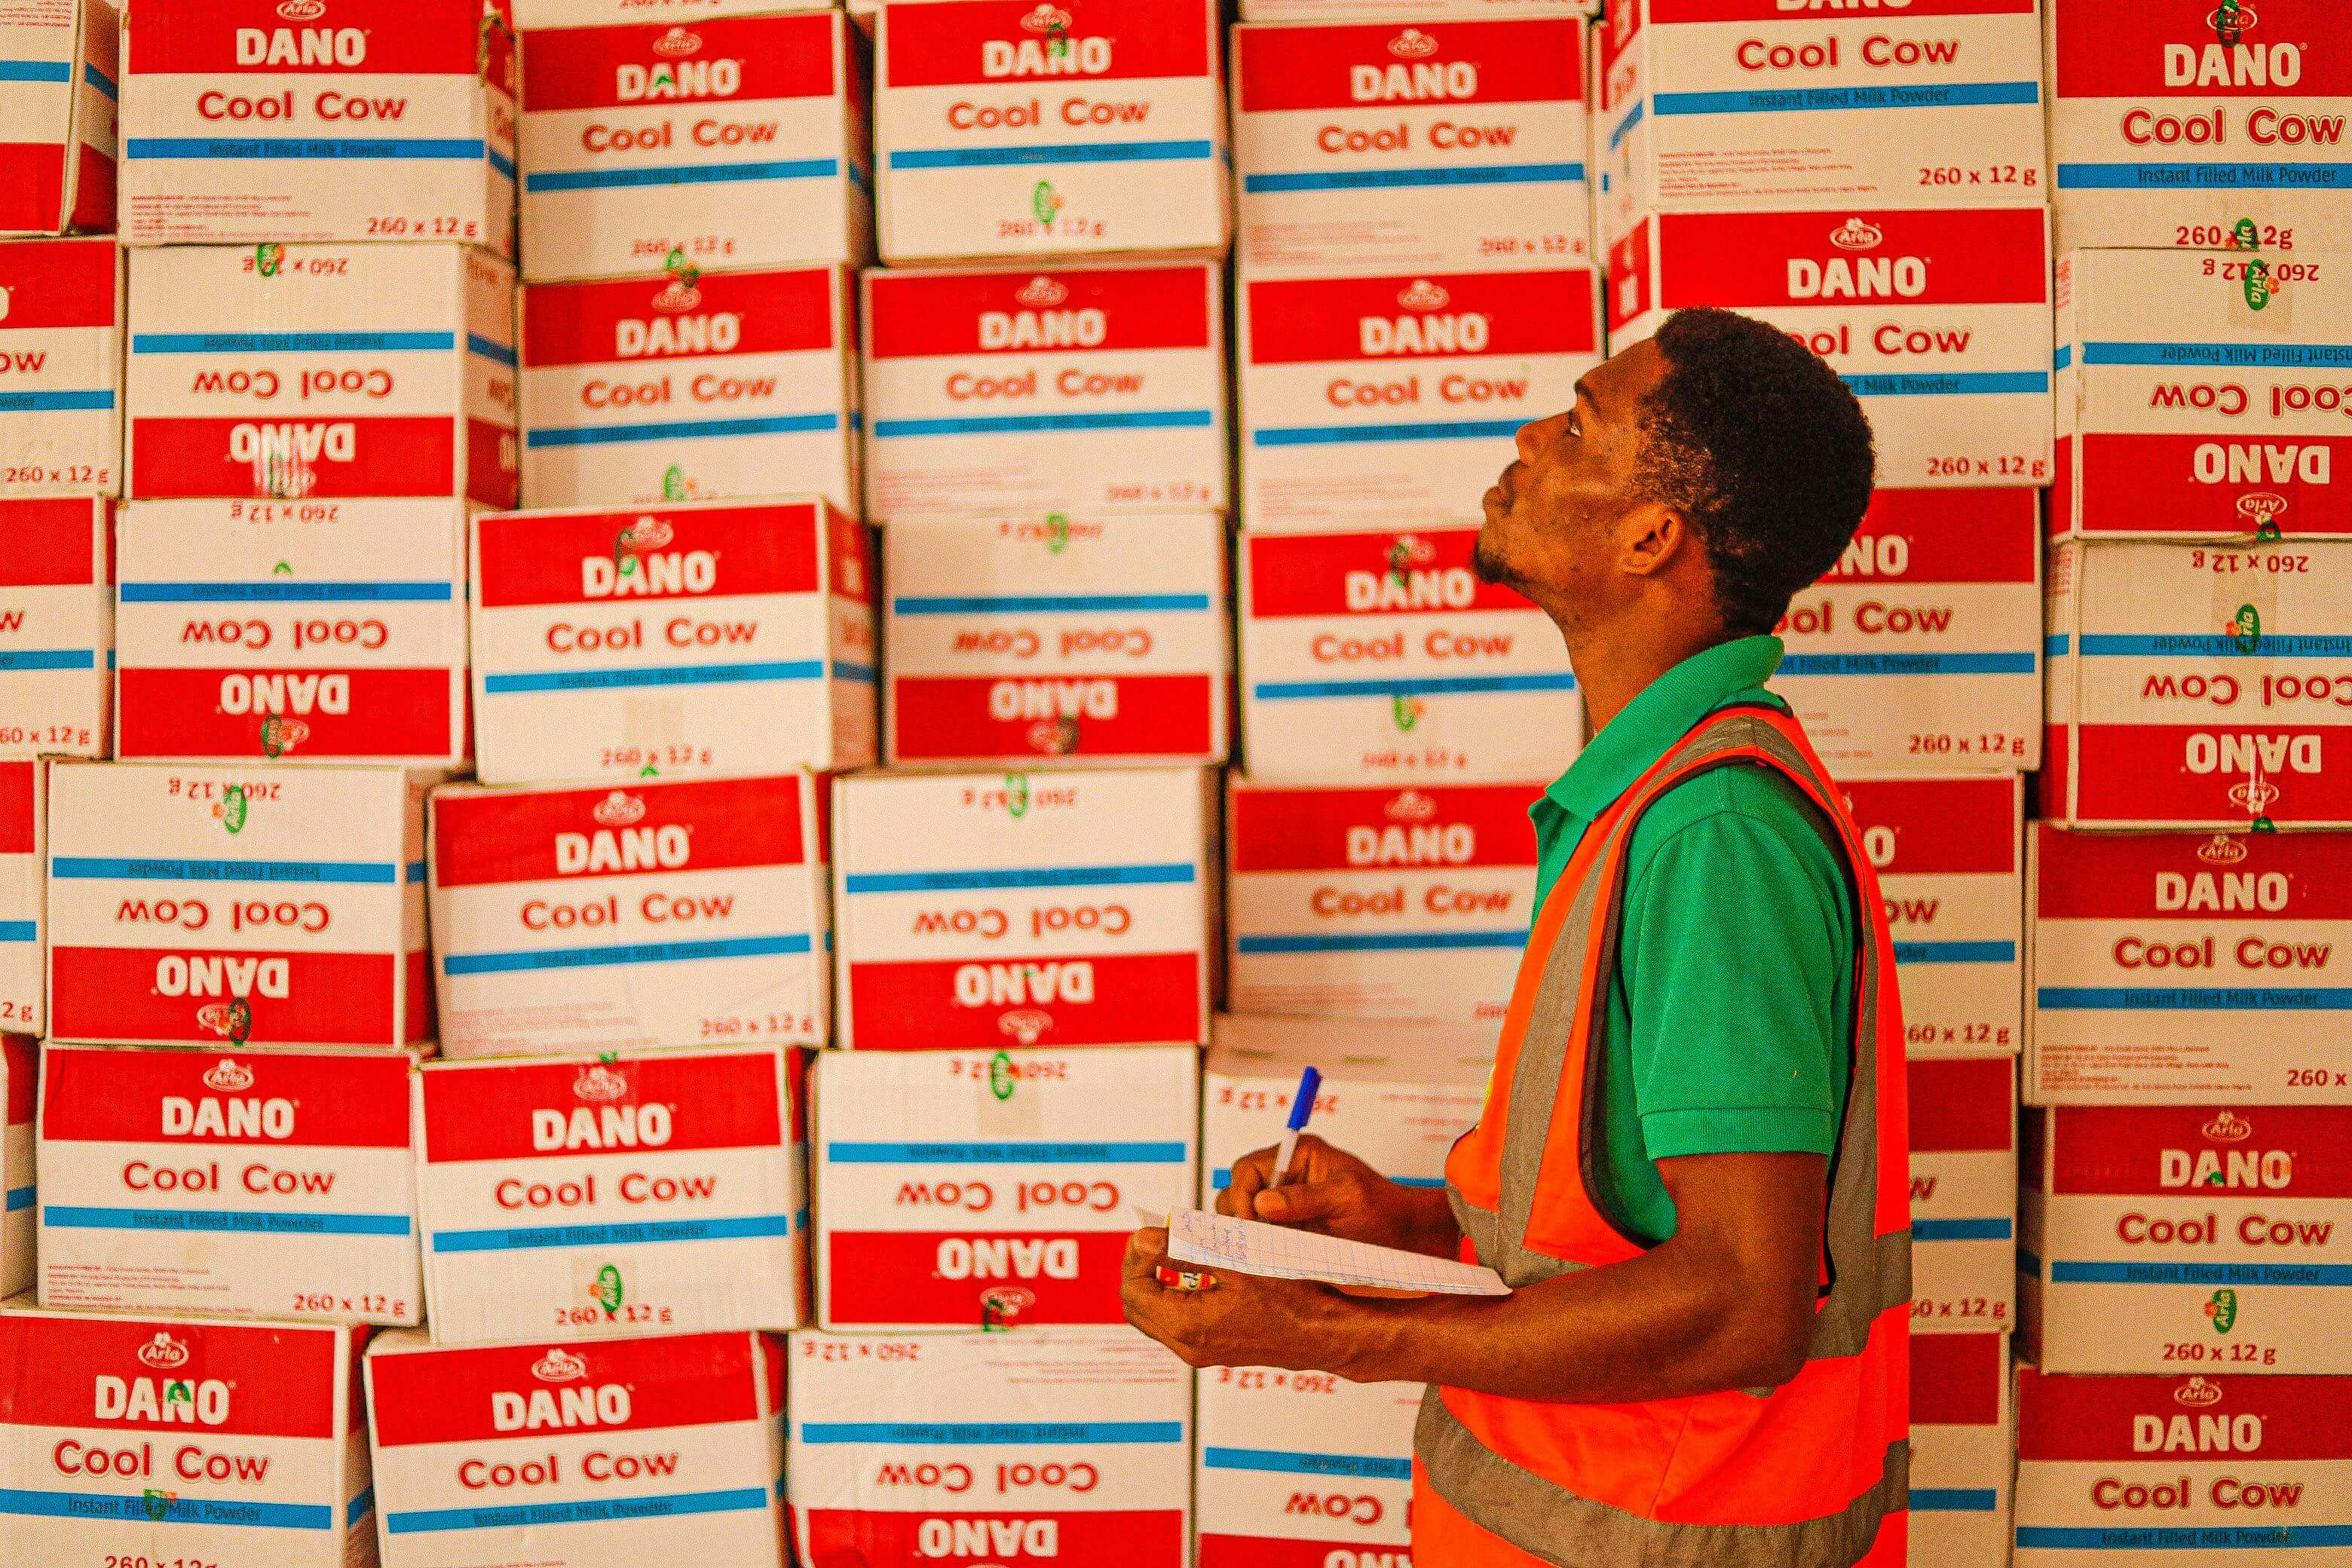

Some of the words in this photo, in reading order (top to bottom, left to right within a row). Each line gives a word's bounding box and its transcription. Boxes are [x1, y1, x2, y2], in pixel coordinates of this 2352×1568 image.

[237, 28, 366, 66] DANO
[983, 37, 1111, 77] DANO
[1736, 36, 1839, 71] Cool
[1861, 35, 1958, 67] Cow
[617, 59, 740, 100] DANO
[2164, 42, 2301, 87] DANO
[1352, 62, 1477, 101] DANO
[197, 90, 292, 121] Cool
[314, 91, 406, 121] Cow
[947, 100, 1040, 130] Cool
[1060, 97, 1150, 127] Cow
[580, 121, 672, 154] Cool
[691, 118, 777, 148] Cow
[1316, 124, 1409, 155] Cool
[1429, 121, 1515, 150] Cow
[2122, 109, 2223, 145] Cool
[2247, 109, 2343, 145] Cow
[1919, 167, 1962, 186] 260
[1970, 172, 1980, 183] x
[1990, 165, 2017, 184] 12
[2023, 169, 2036, 186] g
[2139, 167, 2192, 182] Instant
[2197, 167, 2237, 182] Filled
[2243, 167, 2274, 182] Milk
[2280, 167, 2337, 182] Powder
[2176, 225, 2222, 246] 260
[1787, 256, 1926, 298] DANO
[2203, 259, 2215, 275] g
[2277, 263, 2319, 282] 260
[617, 313, 740, 356] DANO
[979, 309, 1105, 349] DANO
[1361, 314, 1487, 354] DANO
[1873, 324, 1970, 355] Cow
[2162, 346, 2219, 362] Powder
[2225, 348, 2256, 361] Milk
[2262, 348, 2302, 363] Filled
[193, 370, 280, 400] Cow
[301, 369, 394, 400] Cool
[580, 377, 671, 410] Cool
[690, 374, 776, 403] Cow
[945, 371, 1037, 402] Cool
[1056, 369, 1142, 397] Cow
[1326, 377, 1419, 408] Cool
[1439, 375, 1527, 403] Cow
[2151, 384, 2248, 416] Cow
[230, 421, 355, 463] DANO
[1928, 458, 1971, 476] 260
[1999, 456, 2025, 475] 12
[2032, 461, 2044, 477] g
[2194, 443, 2330, 484] DANO
[582, 551, 715, 596] DANO
[2212, 554, 2238, 573] 12
[2267, 555, 2308, 574] 260
[1346, 568, 1474, 610] DANO
[1854, 602, 1952, 634] Cow
[182, 620, 272, 650] Cow
[294, 620, 389, 650] Cool
[546, 620, 643, 654] Cool
[665, 617, 757, 648] Cow
[952, 632, 1040, 657] Cow
[1059, 629, 1153, 657] Cool
[1311, 632, 1404, 663] Cool
[1424, 631, 1511, 659] Cow
[2153, 636, 2211, 650] Powder
[221, 675, 349, 715] DANO
[991, 681, 1116, 718] DANO
[2142, 675, 2240, 706] Cow
[2185, 733, 2321, 774] DANO
[556, 825, 690, 874] DANO
[1348, 825, 1474, 864] DANO
[1309, 887, 1404, 919] Cool
[1423, 885, 1511, 914] Cow
[2156, 872, 2288, 911] DANO
[117, 899, 210, 930] Cow
[232, 902, 330, 933] Cool
[520, 896, 619, 931] Cool
[640, 893, 733, 923] Cow
[914, 908, 1009, 939] Cow
[1031, 904, 1132, 938] Cool
[2114, 937, 2213, 969] Cool
[2236, 938, 2330, 969] Cow
[156, 956, 289, 998] DANO
[955, 962, 1094, 1006] DANO
[2124, 991, 2177, 1004] Instant
[2181, 991, 2221, 1004] Filled
[2226, 992, 2256, 1005] Milk
[2263, 992, 2319, 1005] Powder
[2287, 1069, 2329, 1086] 260
[2335, 1073, 2346, 1086] x
[162, 1097, 294, 1138] DANO
[532, 1103, 672, 1150] DANO
[123, 1161, 219, 1192] Cool
[241, 1163, 335, 1194] Cow
[2161, 1150, 2291, 1189] DANO
[495, 1174, 596, 1210] Cool
[618, 1172, 715, 1204] Cow
[896, 1181, 994, 1213] Cow
[1018, 1181, 1120, 1213] Cool
[2117, 1213, 2216, 1245] Cool
[2238, 1214, 2332, 1246] Cow
[938, 1239, 1078, 1279] DANO
[2265, 1267, 2320, 1281] Powder
[293, 1294, 334, 1311] 260
[363, 1295, 387, 1312] 12
[2164, 1343, 2205, 1361] 260
[2212, 1349, 2222, 1360] x
[2231, 1343, 2257, 1361] 12
[2263, 1348, 2276, 1365] g
[95, 1375, 229, 1425] DANO
[492, 1384, 631, 1431] DANO
[2133, 1413, 2262, 1452] DANO
[54, 1439, 151, 1477] Cool
[174, 1445, 268, 1481] Cow
[458, 1454, 559, 1490] Cool
[581, 1451, 678, 1482] Cow
[877, 1462, 974, 1493] Cow
[997, 1462, 1099, 1493] Cool
[2092, 1478, 2189, 1510] Cool
[2210, 1478, 2302, 1509] Cow
[1285, 1493, 1384, 1526] Cow
[919, 1519, 1058, 1557] DANO
